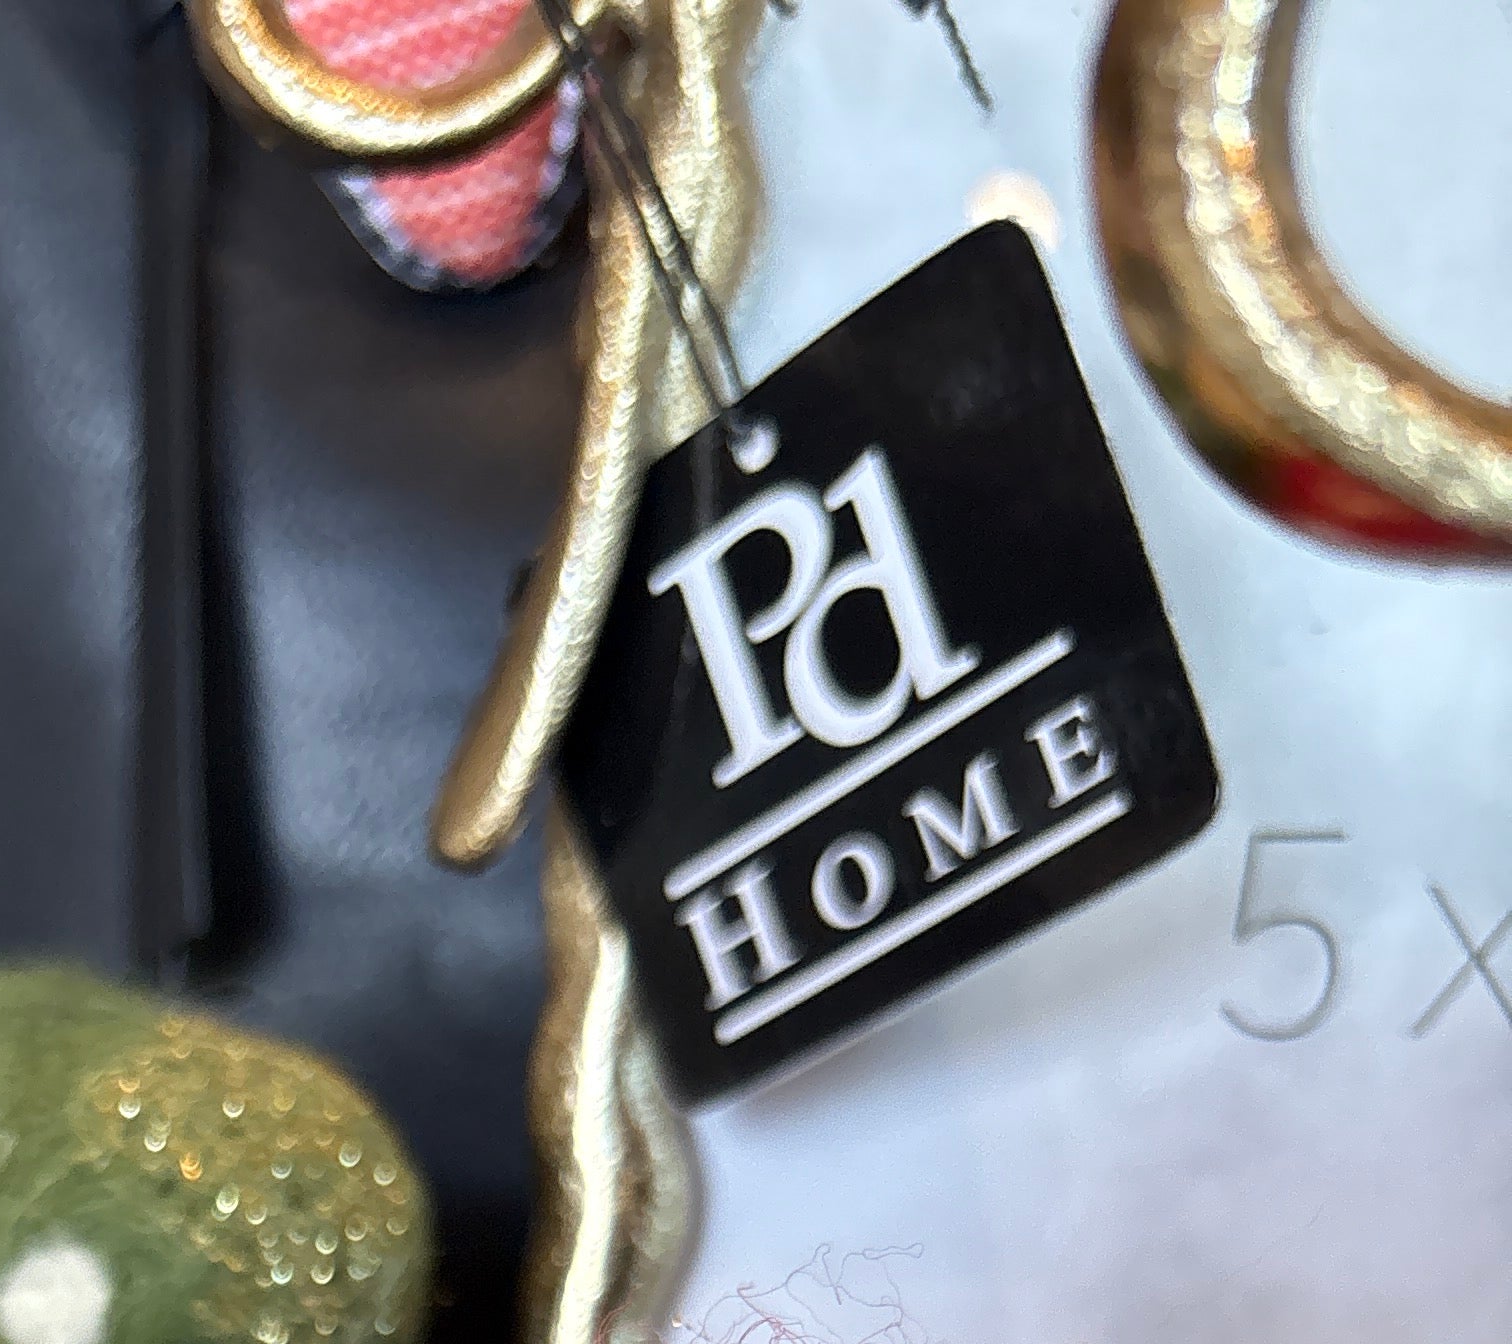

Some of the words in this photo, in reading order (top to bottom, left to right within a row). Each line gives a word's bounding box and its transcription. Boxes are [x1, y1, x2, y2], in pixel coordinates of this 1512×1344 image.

[648, 445, 977, 790] Pd
[675, 698, 1118, 1011] HOME
[1219, 828, 1350, 1041] 5
